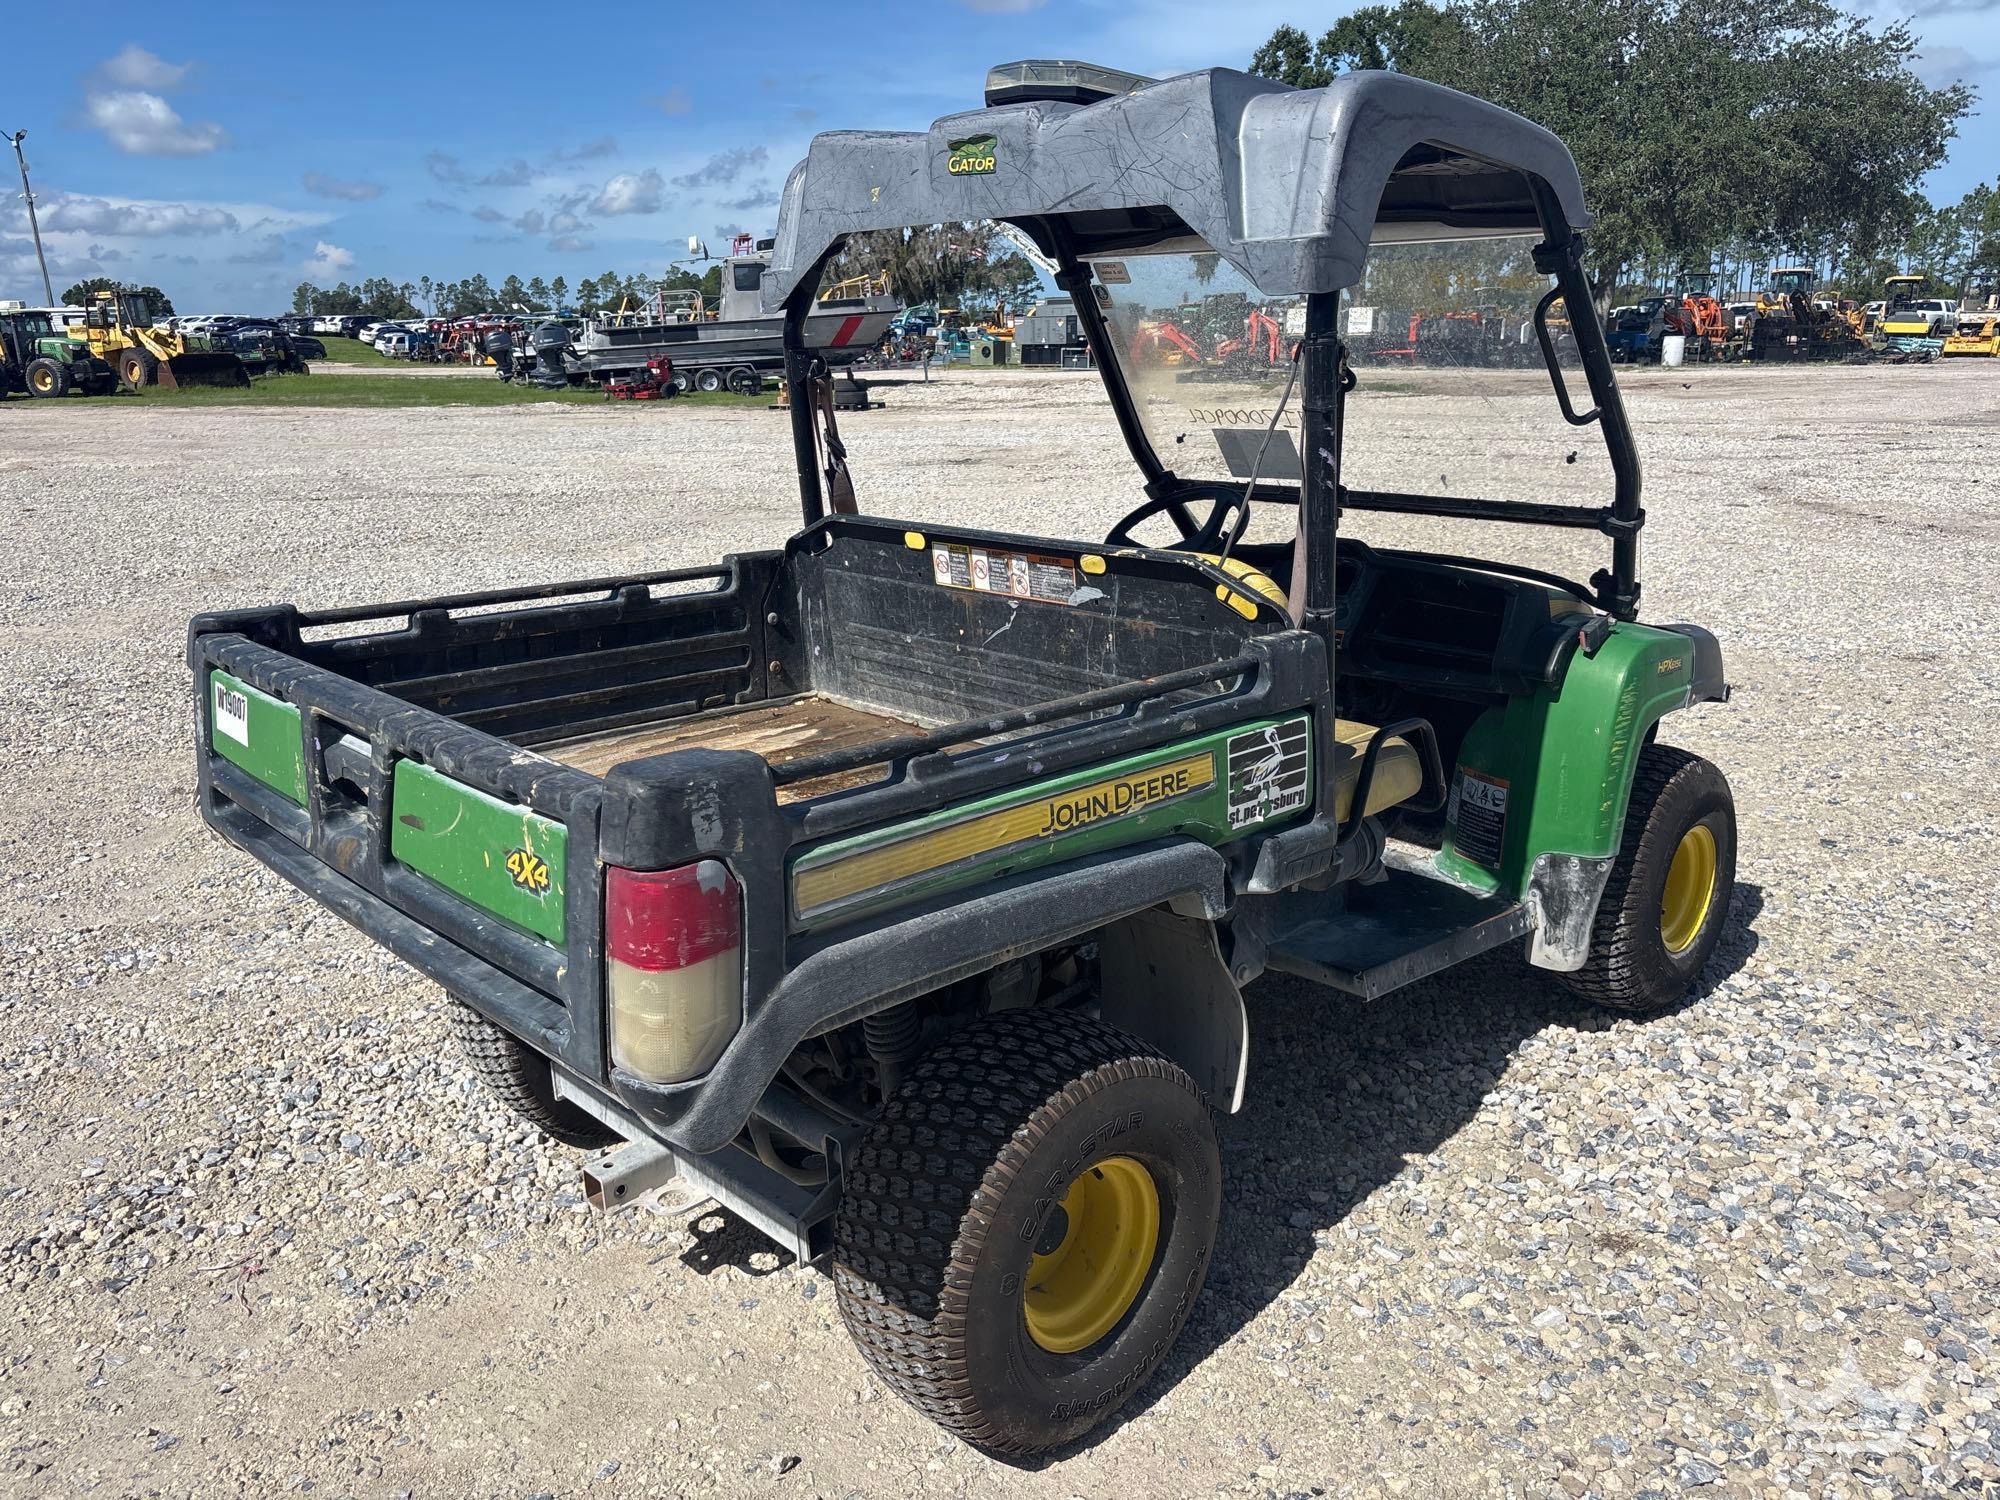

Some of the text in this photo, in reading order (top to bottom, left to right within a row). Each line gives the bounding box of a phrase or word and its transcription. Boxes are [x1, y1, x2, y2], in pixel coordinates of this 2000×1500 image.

[948, 156, 995, 173] GATOR
[1041, 768, 1189, 833] JOHN DEERE
[1019, 1109, 1145, 1242] CARLSTAR
